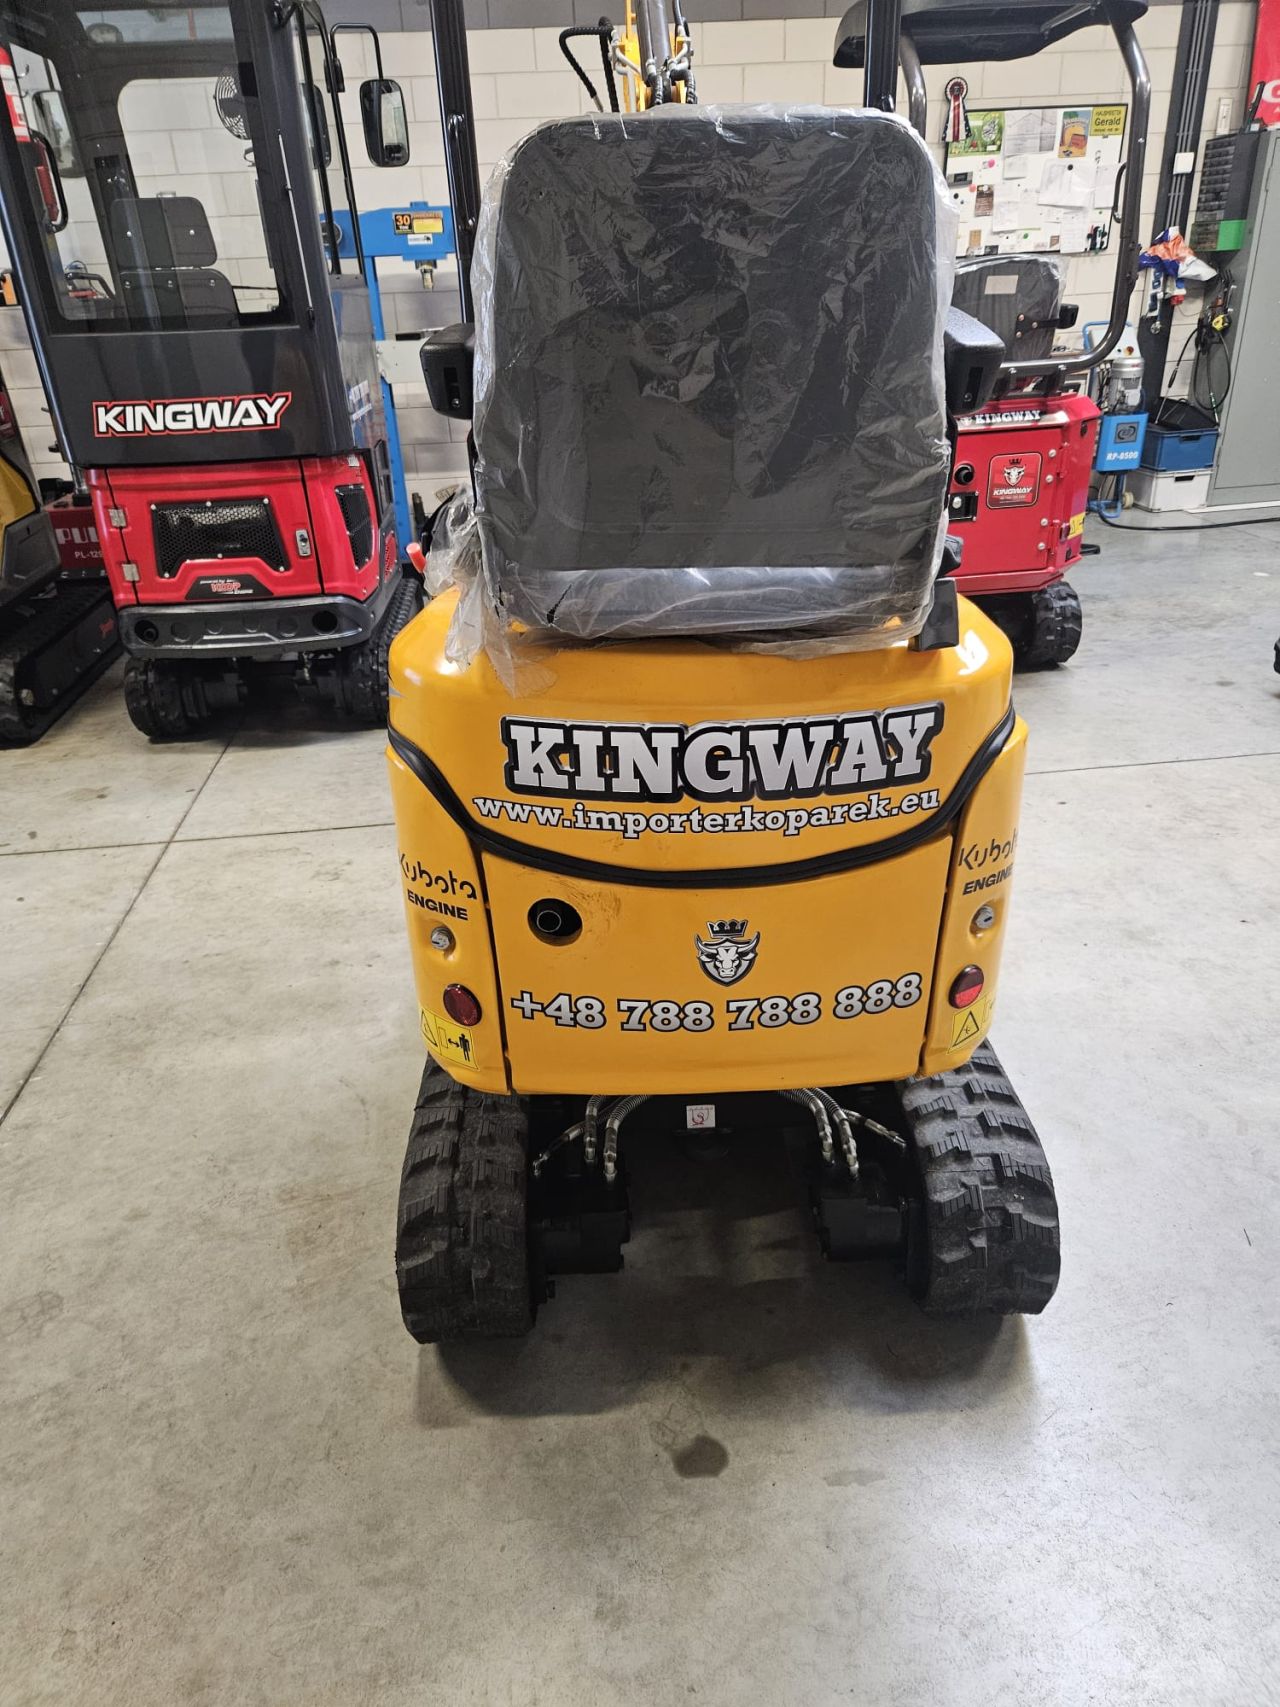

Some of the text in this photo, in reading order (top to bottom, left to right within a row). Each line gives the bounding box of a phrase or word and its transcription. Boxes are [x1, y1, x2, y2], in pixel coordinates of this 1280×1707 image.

[1094, 116, 1122, 127] Gerald
[395, 214, 411, 226] 30
[95, 395, 289, 435] KINGWAY
[974, 409, 1041, 425] KINGWAY
[992, 486, 1033, 496] KINGWAY
[504, 705, 940, 799] KINGWAY
[473, 789, 940, 839] www.importerkoparek.eu
[958, 827, 1018, 870] Kubot
[407, 888, 469, 921] ENGINE
[510, 972, 923, 1032] +48 788 788 888
